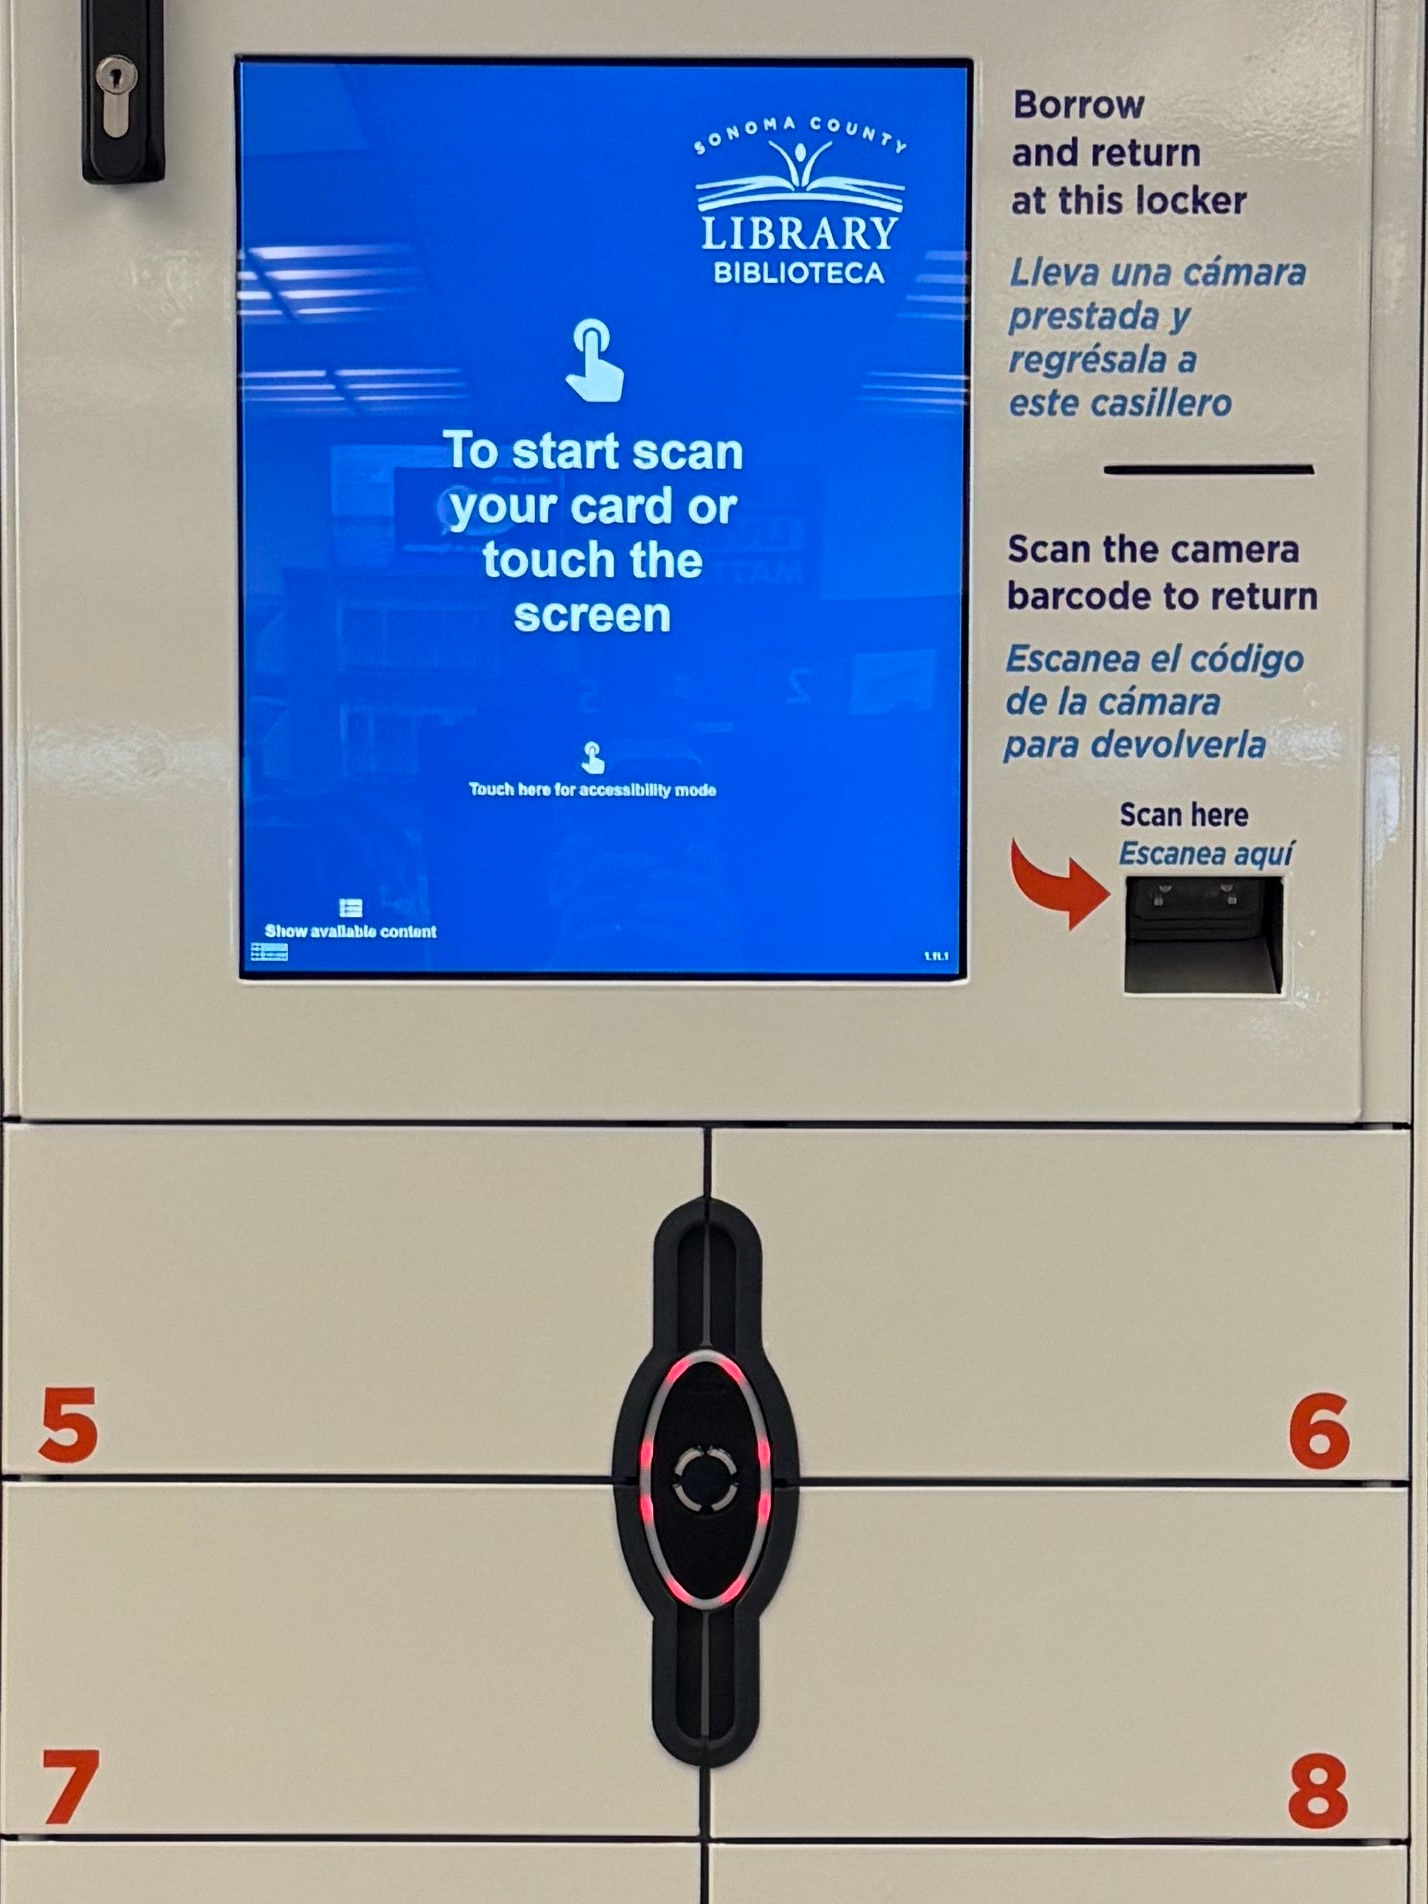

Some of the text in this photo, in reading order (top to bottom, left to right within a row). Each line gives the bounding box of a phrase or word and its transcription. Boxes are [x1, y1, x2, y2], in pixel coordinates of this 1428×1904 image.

[1014, 88, 1146, 120] Borrow
[693, 115, 908, 156] SONOMA COUNTY
[1012, 135, 1201, 168] and return
[1011, 183, 1248, 217] at this locker
[701, 216, 899, 250] LIBRARY
[714, 261, 885, 284] BIBLIOTECA
[1010, 253, 1307, 287] Lleva una cámara
[1007, 298, 1193, 337] prestada y
[1008, 341, 1198, 380] regrésala a
[1009, 386, 1233, 418] este casillero
[442, 429, 743, 470] To start scan
[450, 485, 738, 532] your card or
[482, 539, 615, 578] touch
[629, 540, 703, 578] the
[1007, 532, 1300, 564] Scan the camera
[1007, 579, 1318, 611] barcode to return
[514, 602, 670, 632] screen
[1005, 641, 1305, 679] Escanea el código
[1005, 684, 1221, 716] de la cámara
[1002, 727, 1267, 765] para devolverla
[468, 781, 717, 800] Touch here for accessibility mode
[1120, 800, 1250, 828] Scan here
[1118, 838, 1298, 872] Escanea aquí
[264, 923, 438, 939] Show available content
[39, 1387, 97, 1464] 5
[1289, 1393, 1350, 1470] 6
[42, 1750, 99, 1825] 7
[1288, 1753, 1348, 1830] 8
